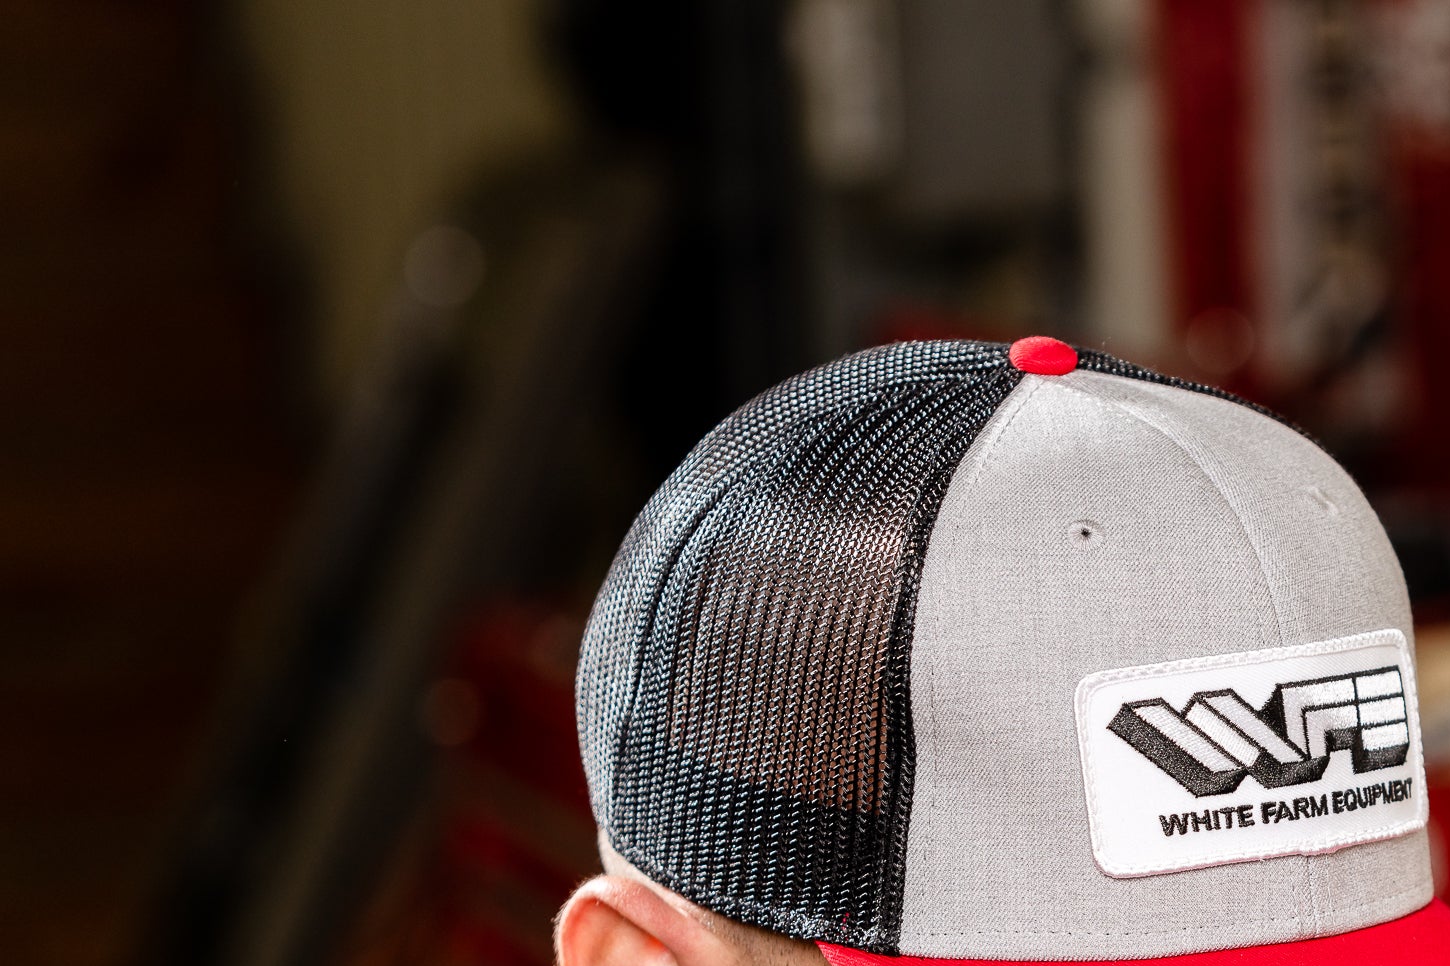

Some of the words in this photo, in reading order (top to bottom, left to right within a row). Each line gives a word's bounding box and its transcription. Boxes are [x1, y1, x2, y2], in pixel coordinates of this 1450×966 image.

[1159, 805, 1255, 836] WHITE
[1260, 794, 1329, 825] FARM
[1332, 778, 1413, 813] EQUIPMENT
